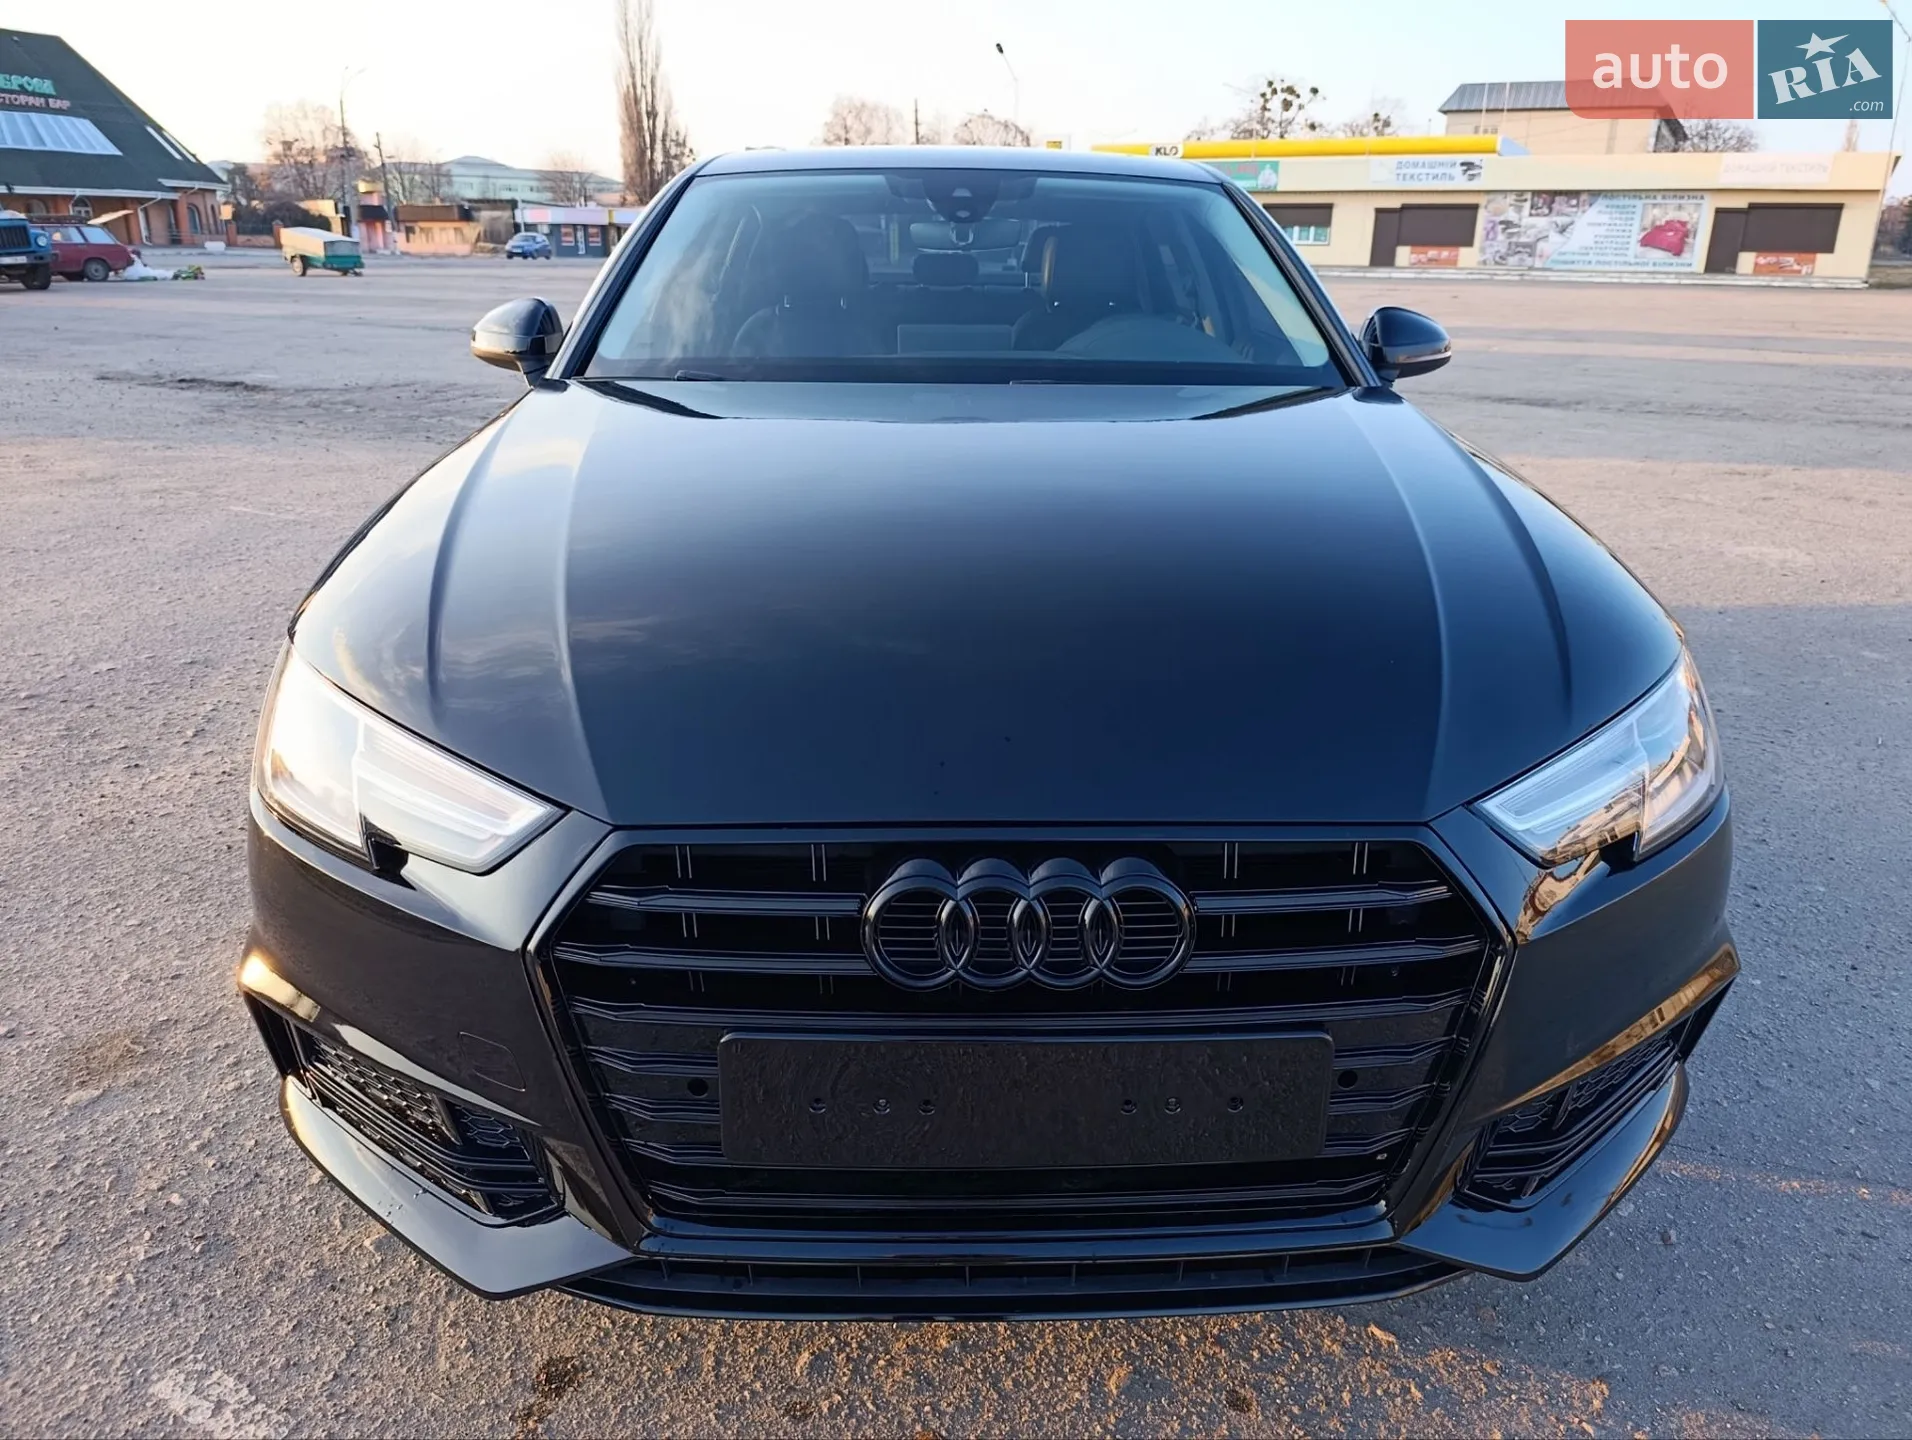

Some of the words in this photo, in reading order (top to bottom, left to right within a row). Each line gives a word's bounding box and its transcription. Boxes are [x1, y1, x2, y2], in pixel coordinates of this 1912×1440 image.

[1155, 146, 1179, 156] KLO
[1396, 159, 1458, 170] ДОМАШНІЙ
[1396, 172, 1456, 182] ТЕКСТИЛЬ
